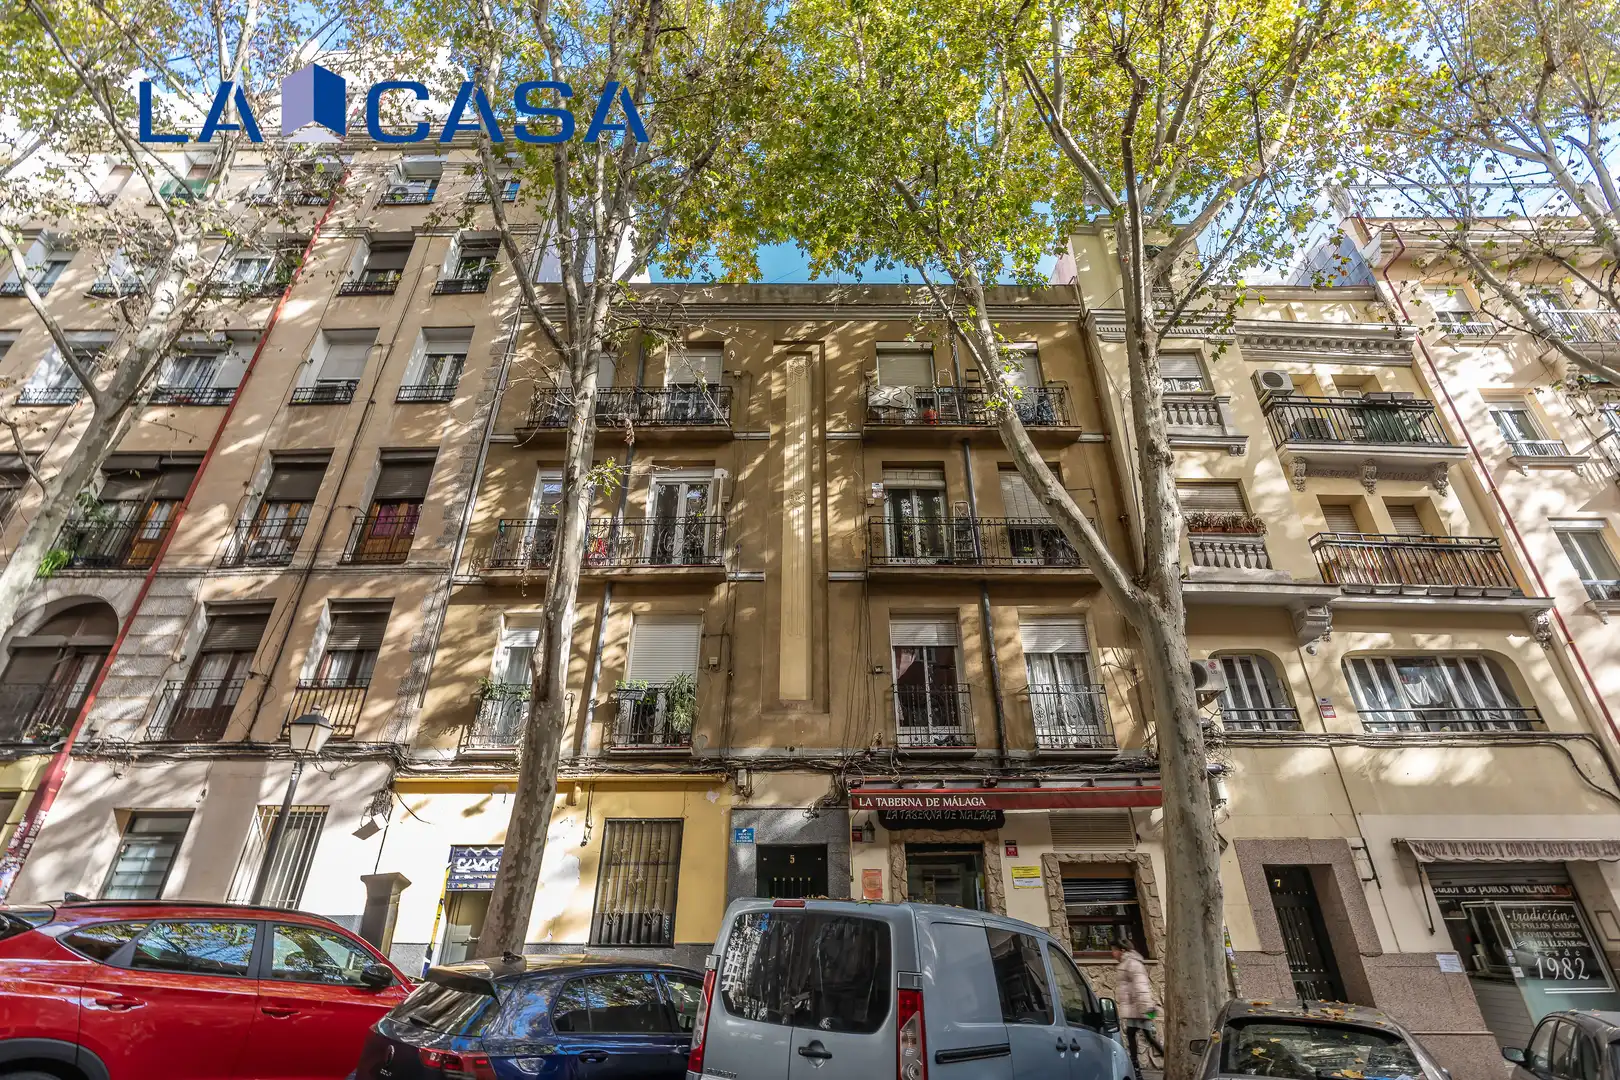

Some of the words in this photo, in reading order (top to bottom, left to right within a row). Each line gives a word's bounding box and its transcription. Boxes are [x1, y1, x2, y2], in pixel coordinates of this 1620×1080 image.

[859, 797, 873, 807] LA
[876, 797, 923, 807] TABERNA
[926, 797, 940, 807] DE
[943, 795, 986, 807] MÁLAGA
[886, 810, 898, 820] LA
[900, 810, 941, 820] TABERNA
[943, 810, 957, 820] DE
[1461, 842, 1495, 856] POLLOS
[1505, 842, 1541, 857] COMIDA
[789, 854, 796, 864] 5
[1274, 878, 1281, 888] 7
[1512, 907, 1570, 921] tradición
[1535, 957, 1590, 980] 1982
